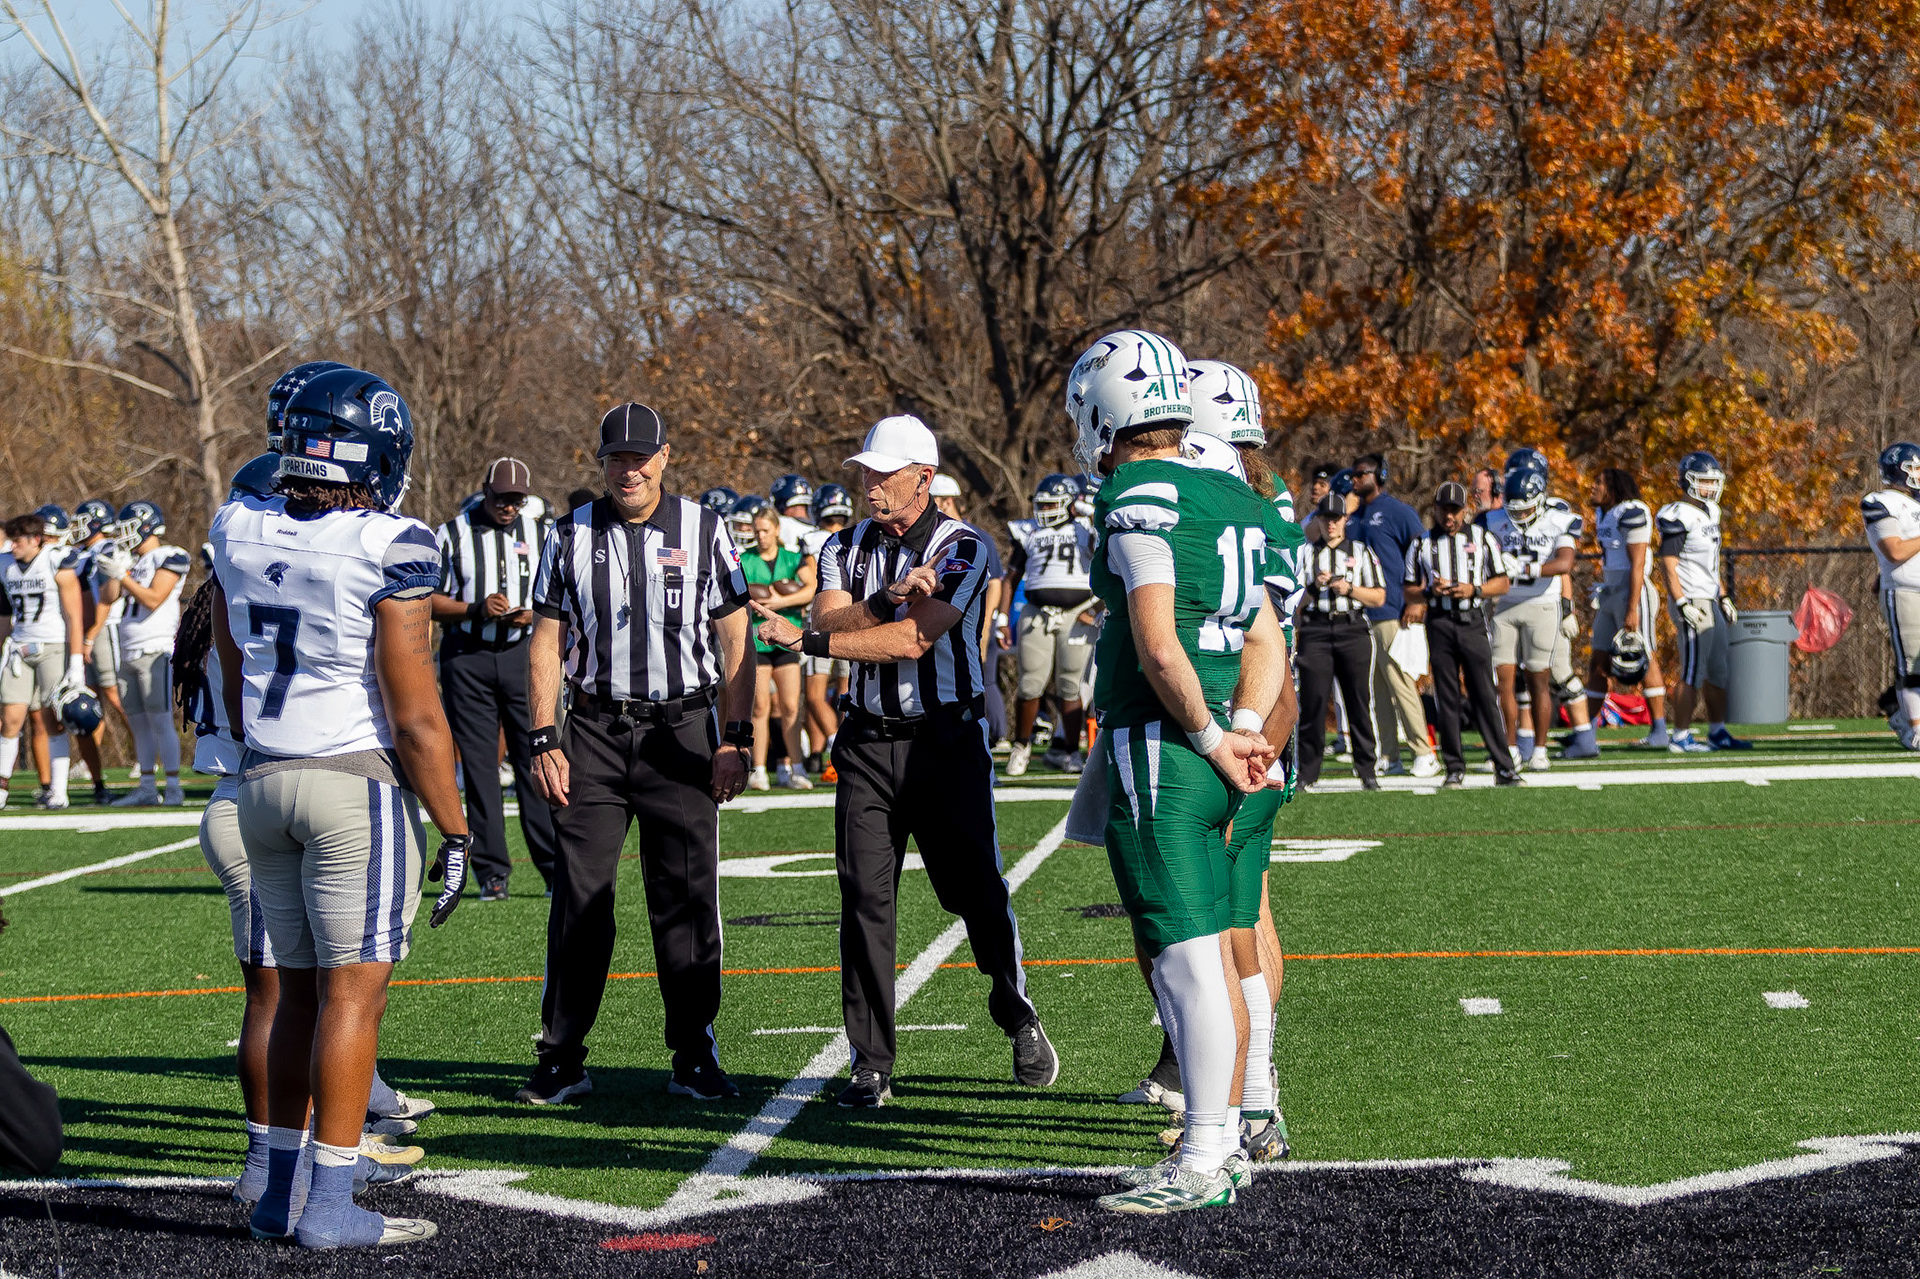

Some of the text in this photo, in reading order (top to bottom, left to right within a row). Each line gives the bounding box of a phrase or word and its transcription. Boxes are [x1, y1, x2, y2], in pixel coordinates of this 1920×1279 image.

[302, 416, 309, 427] 7
[283, 460, 328, 477] SPARTANS
[276, 529, 298, 537] Riddell
[1039, 543, 1075, 575] 79
[520, 562, 529, 577] L
[666, 589, 681, 609] U
[247, 601, 302, 721] 7
